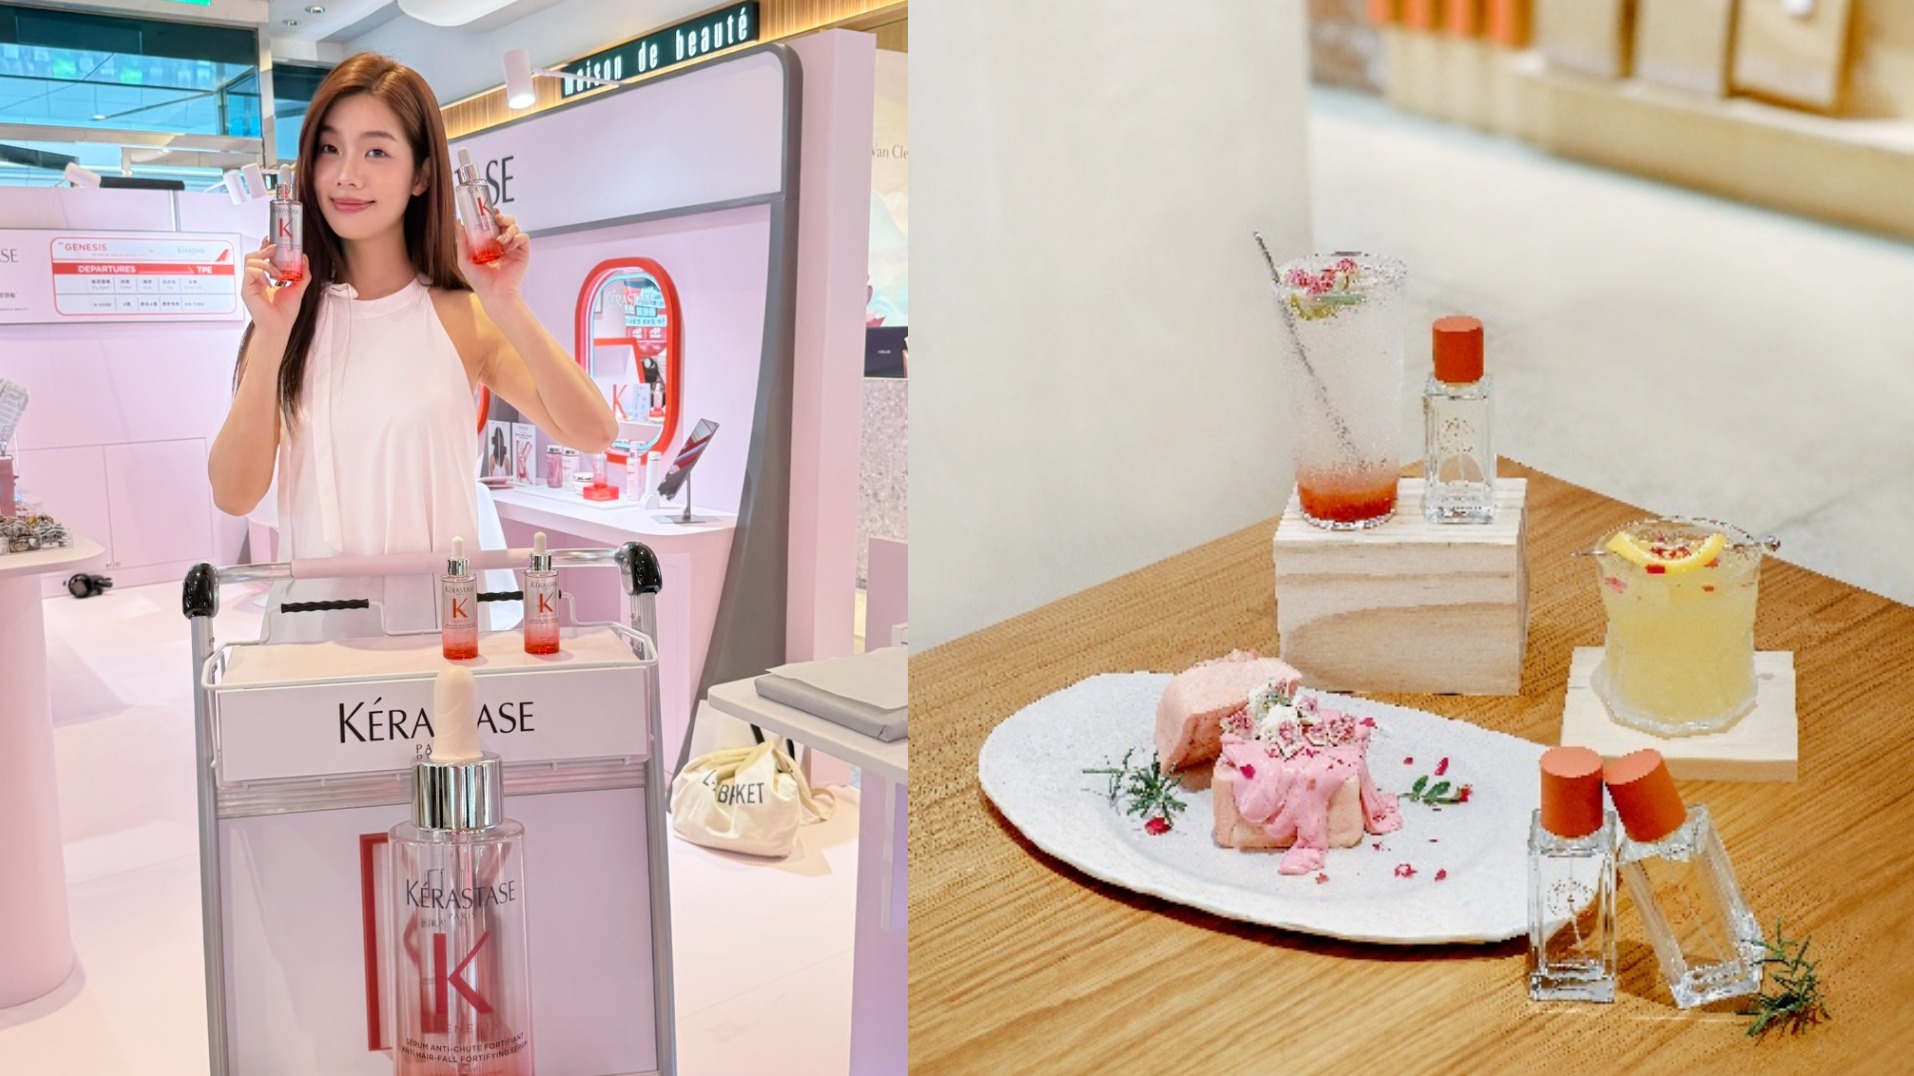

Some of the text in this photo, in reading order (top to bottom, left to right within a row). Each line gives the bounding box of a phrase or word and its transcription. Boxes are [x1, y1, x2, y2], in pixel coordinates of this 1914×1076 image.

[565, 6, 748, 96] maison de beauté
[477, 196, 492, 217] K
[279, 217, 293, 238] K
[64, 243, 107, 252] GENESIS
[77, 265, 213, 274] DEPARTURES TPE
[452, 597, 469, 619] K
[538, 592, 554, 614] K
[338, 696, 536, 744] KÉRAASE
[406, 879, 516, 909] KÉRASTASE
[433, 932, 494, 1015] K
[430, 1043, 483, 1053] ANTI-CHUTE
